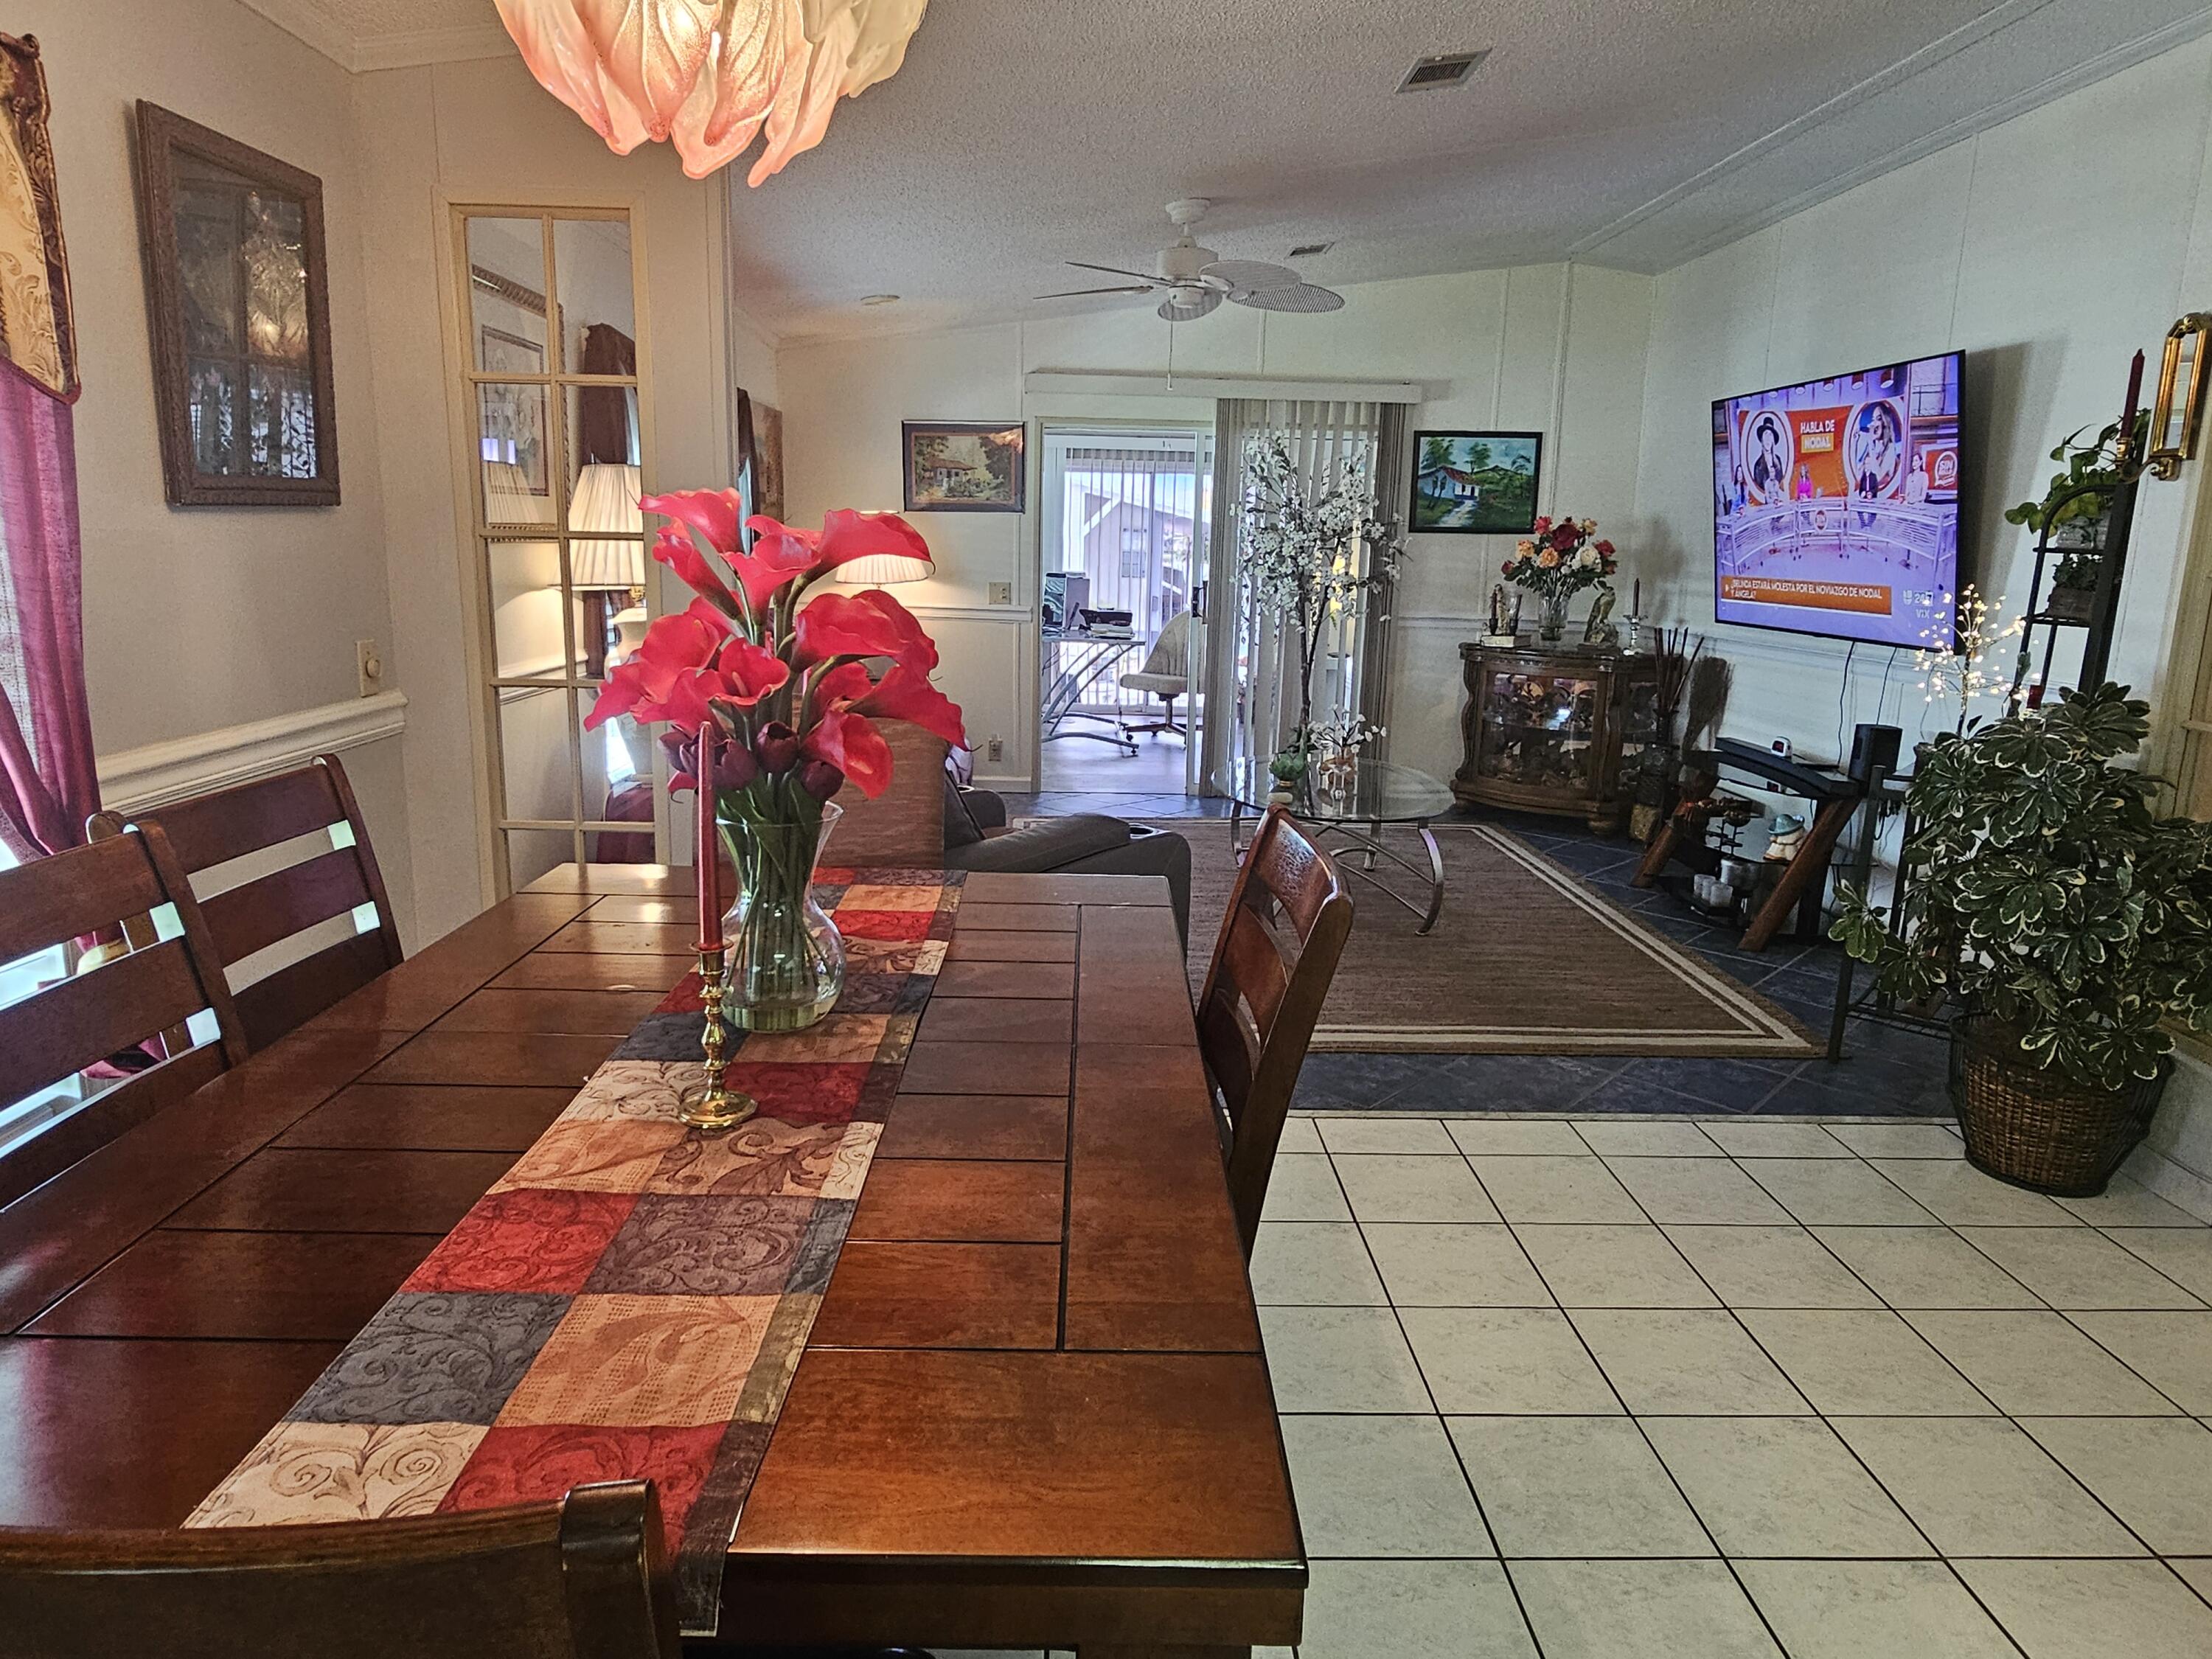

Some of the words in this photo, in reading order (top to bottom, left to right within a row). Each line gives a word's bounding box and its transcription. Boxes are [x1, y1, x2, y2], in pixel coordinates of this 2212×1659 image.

[1801, 421, 1824, 434] HABLA
[1825, 420, 1834, 432] DE
[1804, 437, 1831, 449] NODAL
[1771, 582, 1795, 591] MOLESTA
[1796, 584, 1807, 593] POR
[1809, 585, 1815, 594] EL
[1816, 585, 1848, 596] NOVIAZGO
[1849, 588, 1858, 597] DE
[1859, 588, 1882, 599] NODAL
